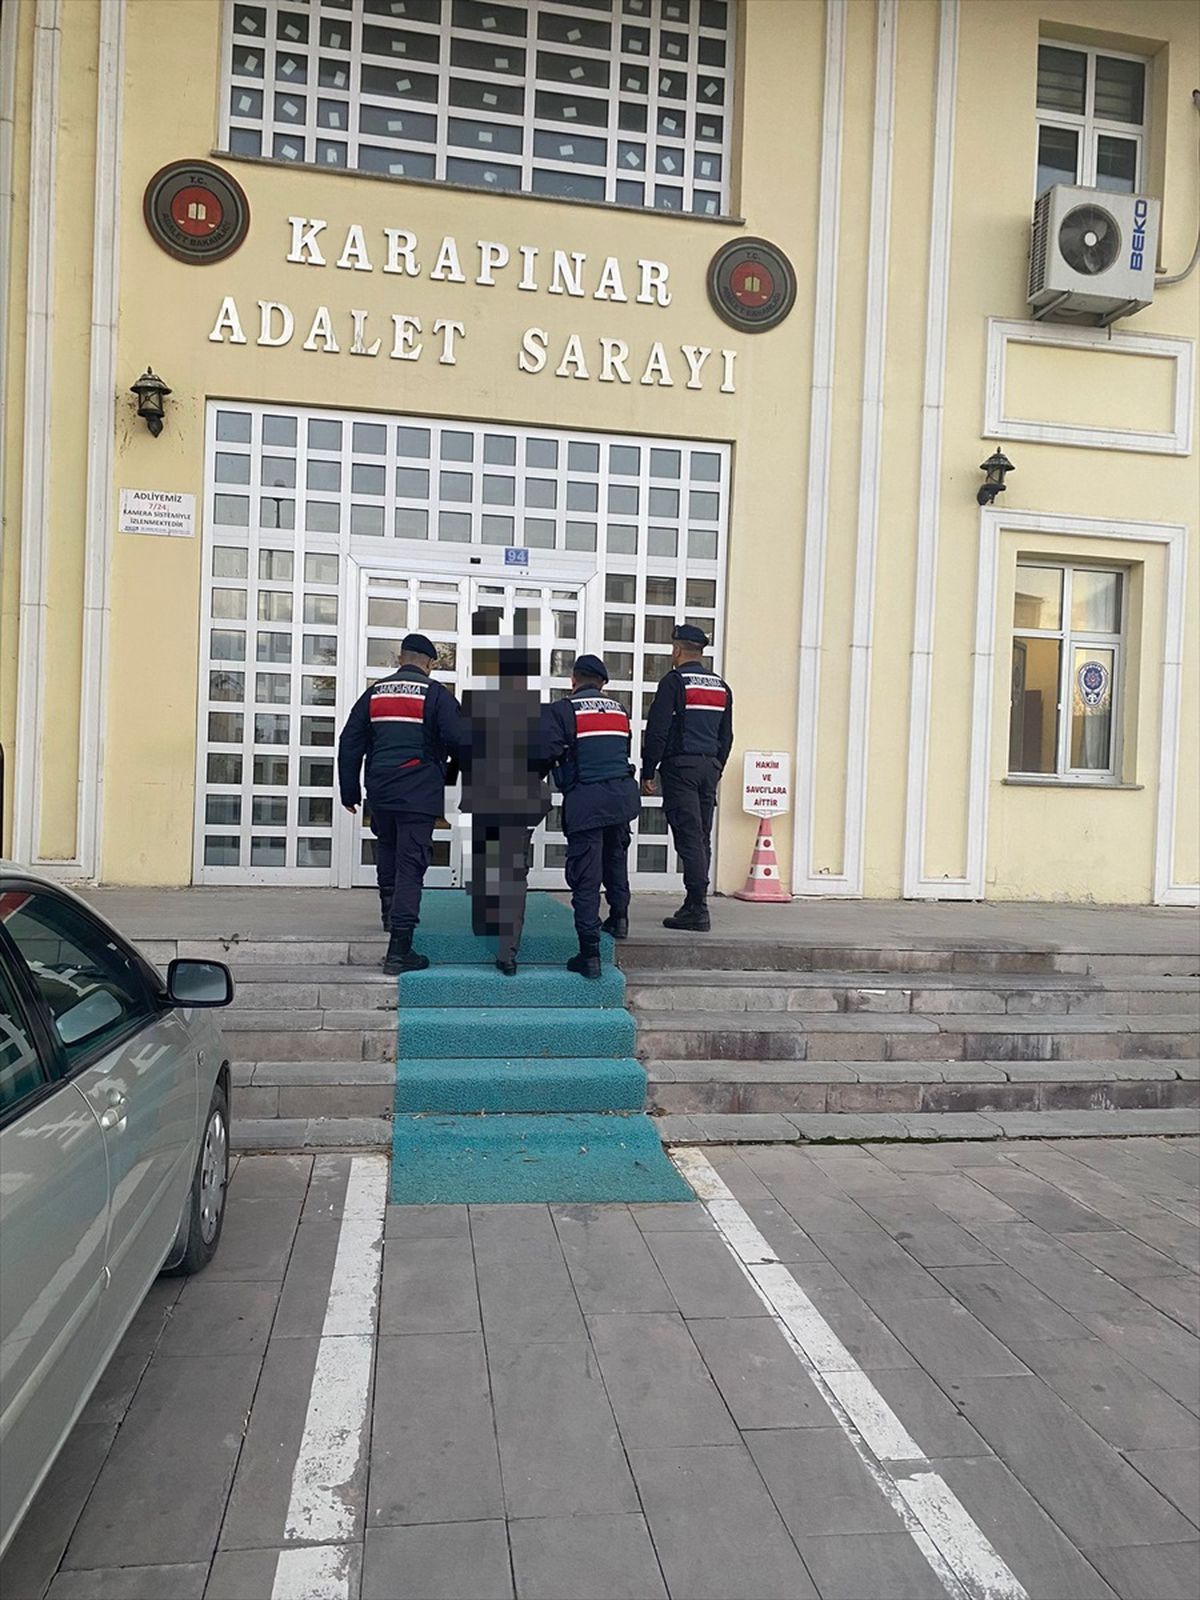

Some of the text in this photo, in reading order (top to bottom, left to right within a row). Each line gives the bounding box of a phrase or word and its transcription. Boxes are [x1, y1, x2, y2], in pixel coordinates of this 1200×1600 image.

[1130, 199, 1148, 271] BEKO
[287, 216, 673, 307] KARAPINAR
[208, 296, 737, 393] ADALET SARAYI
[133, 492, 182, 503] ADLİYEMİZ
[507, 550, 526, 561] 94
[688, 676, 722, 687] JANDARMA
[375, 683, 424, 695] JANDARMA
[579, 700, 623, 712] JANDARMA
[755, 760, 779, 769] HAKİM
[762, 773, 772, 782] VE
[754, 798, 778, 807] AİTTİR
